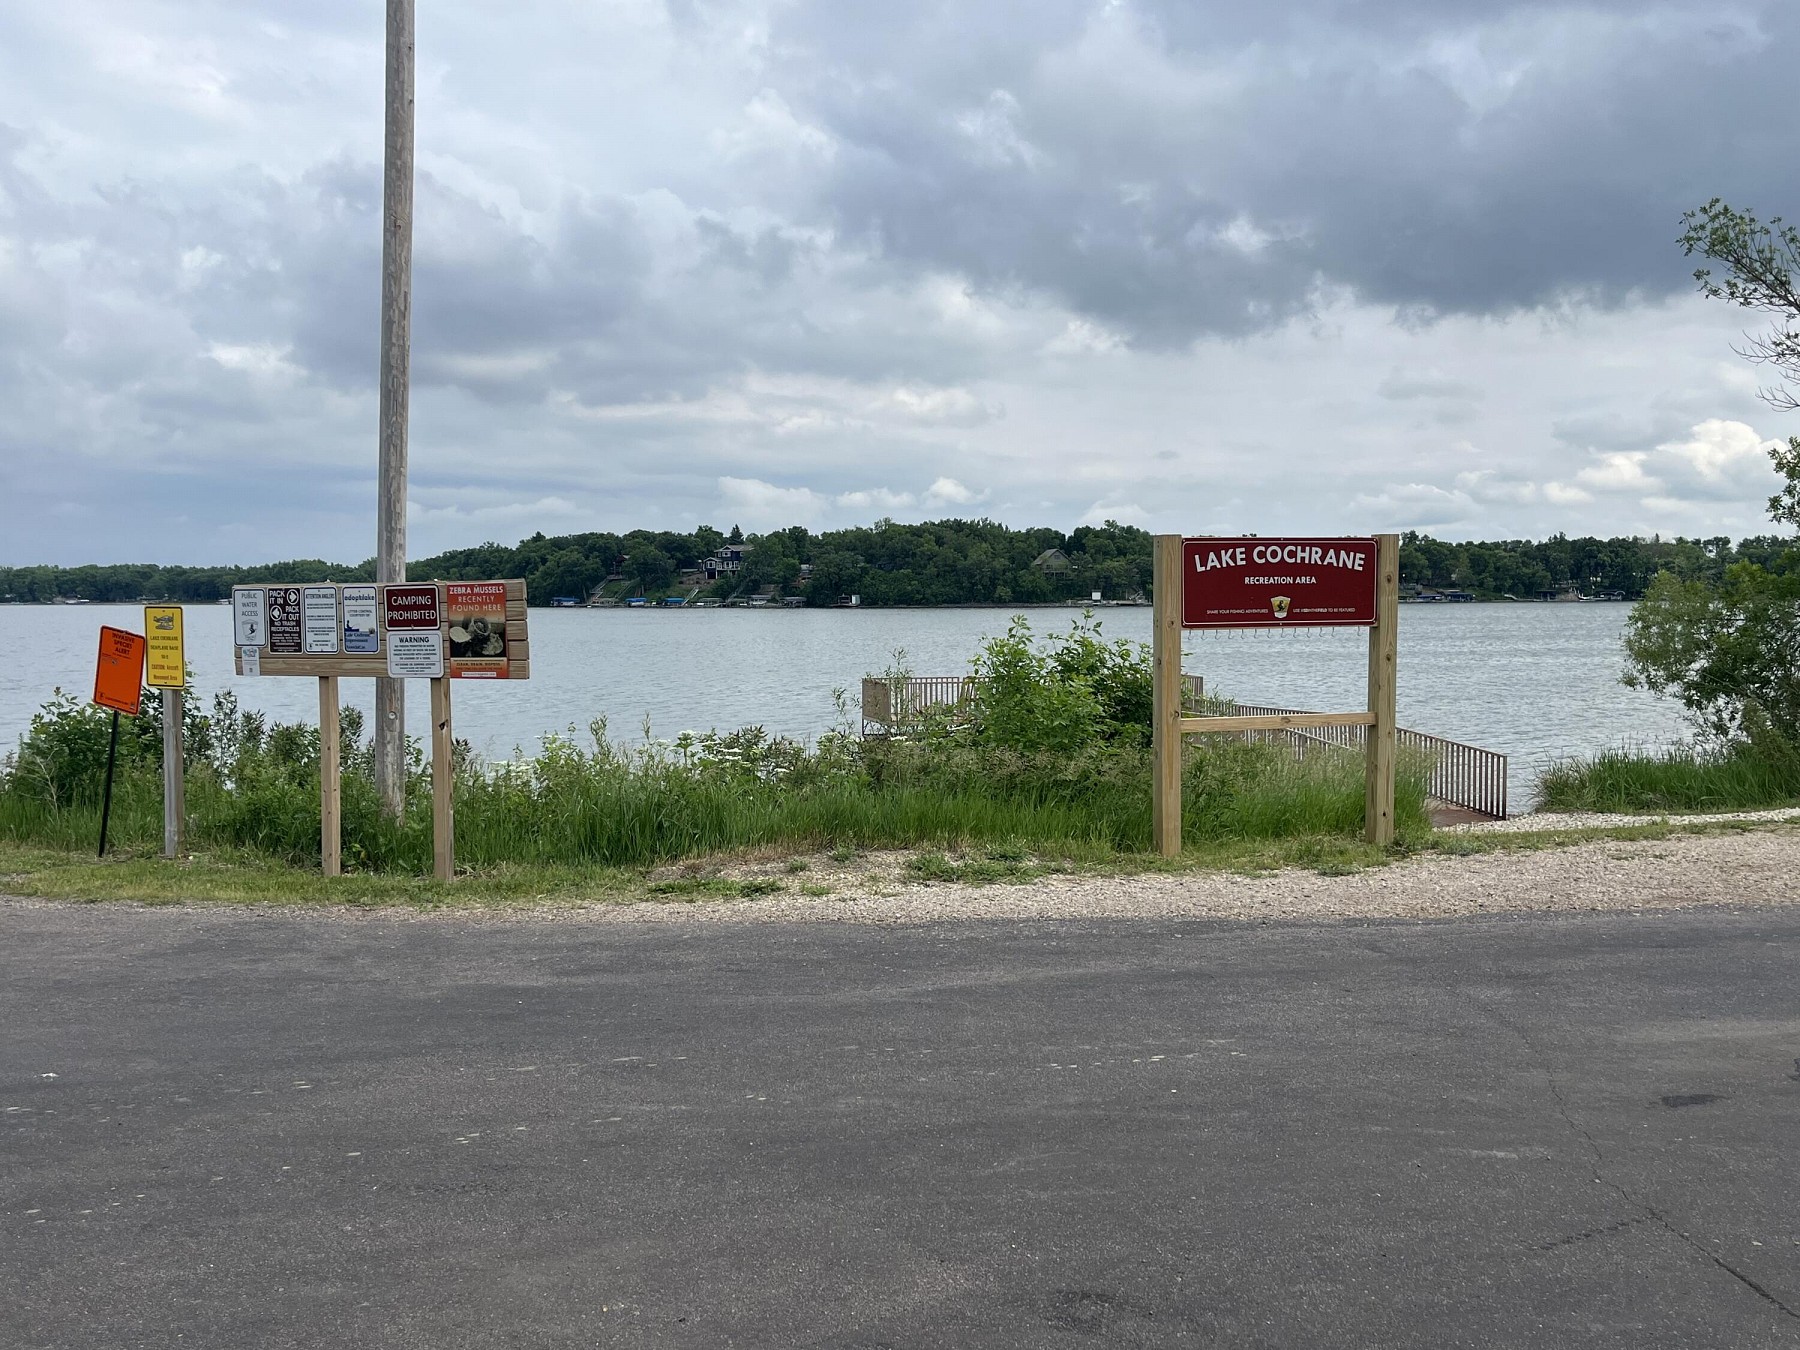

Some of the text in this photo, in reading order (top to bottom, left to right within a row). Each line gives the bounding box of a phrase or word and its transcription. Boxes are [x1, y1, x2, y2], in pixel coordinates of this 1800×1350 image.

[1194, 546, 1366, 572] LAKE COCHRANE
[392, 596, 431, 605] CAMPING
[388, 610, 436, 620] PROHIBITED
[114, 639, 132, 649] SPECIES
[115, 647, 130, 655] ALERT
